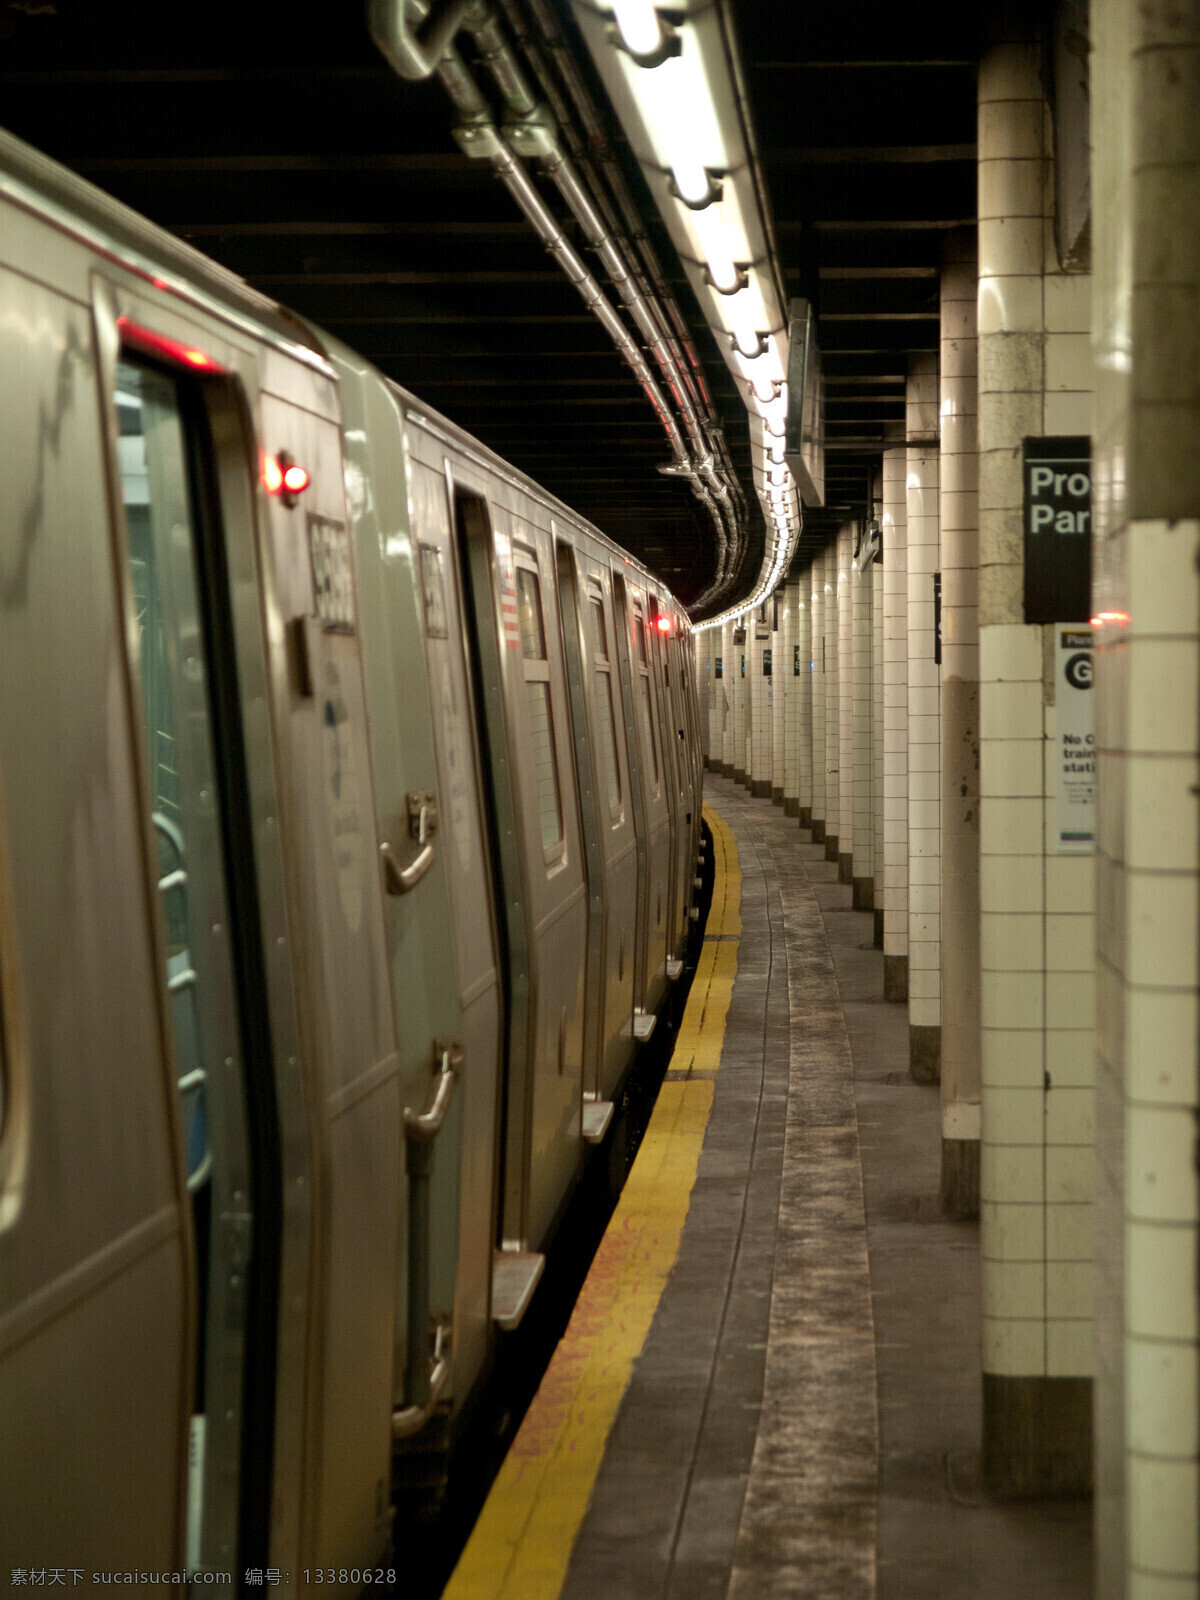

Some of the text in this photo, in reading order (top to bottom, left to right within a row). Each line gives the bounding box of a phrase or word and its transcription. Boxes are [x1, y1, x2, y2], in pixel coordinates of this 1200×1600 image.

[1031, 466, 1090, 497] Pro
[1031, 503, 1090, 534] Par
[1073, 660, 1092, 682] G
[1063, 734, 1082, 745] No
